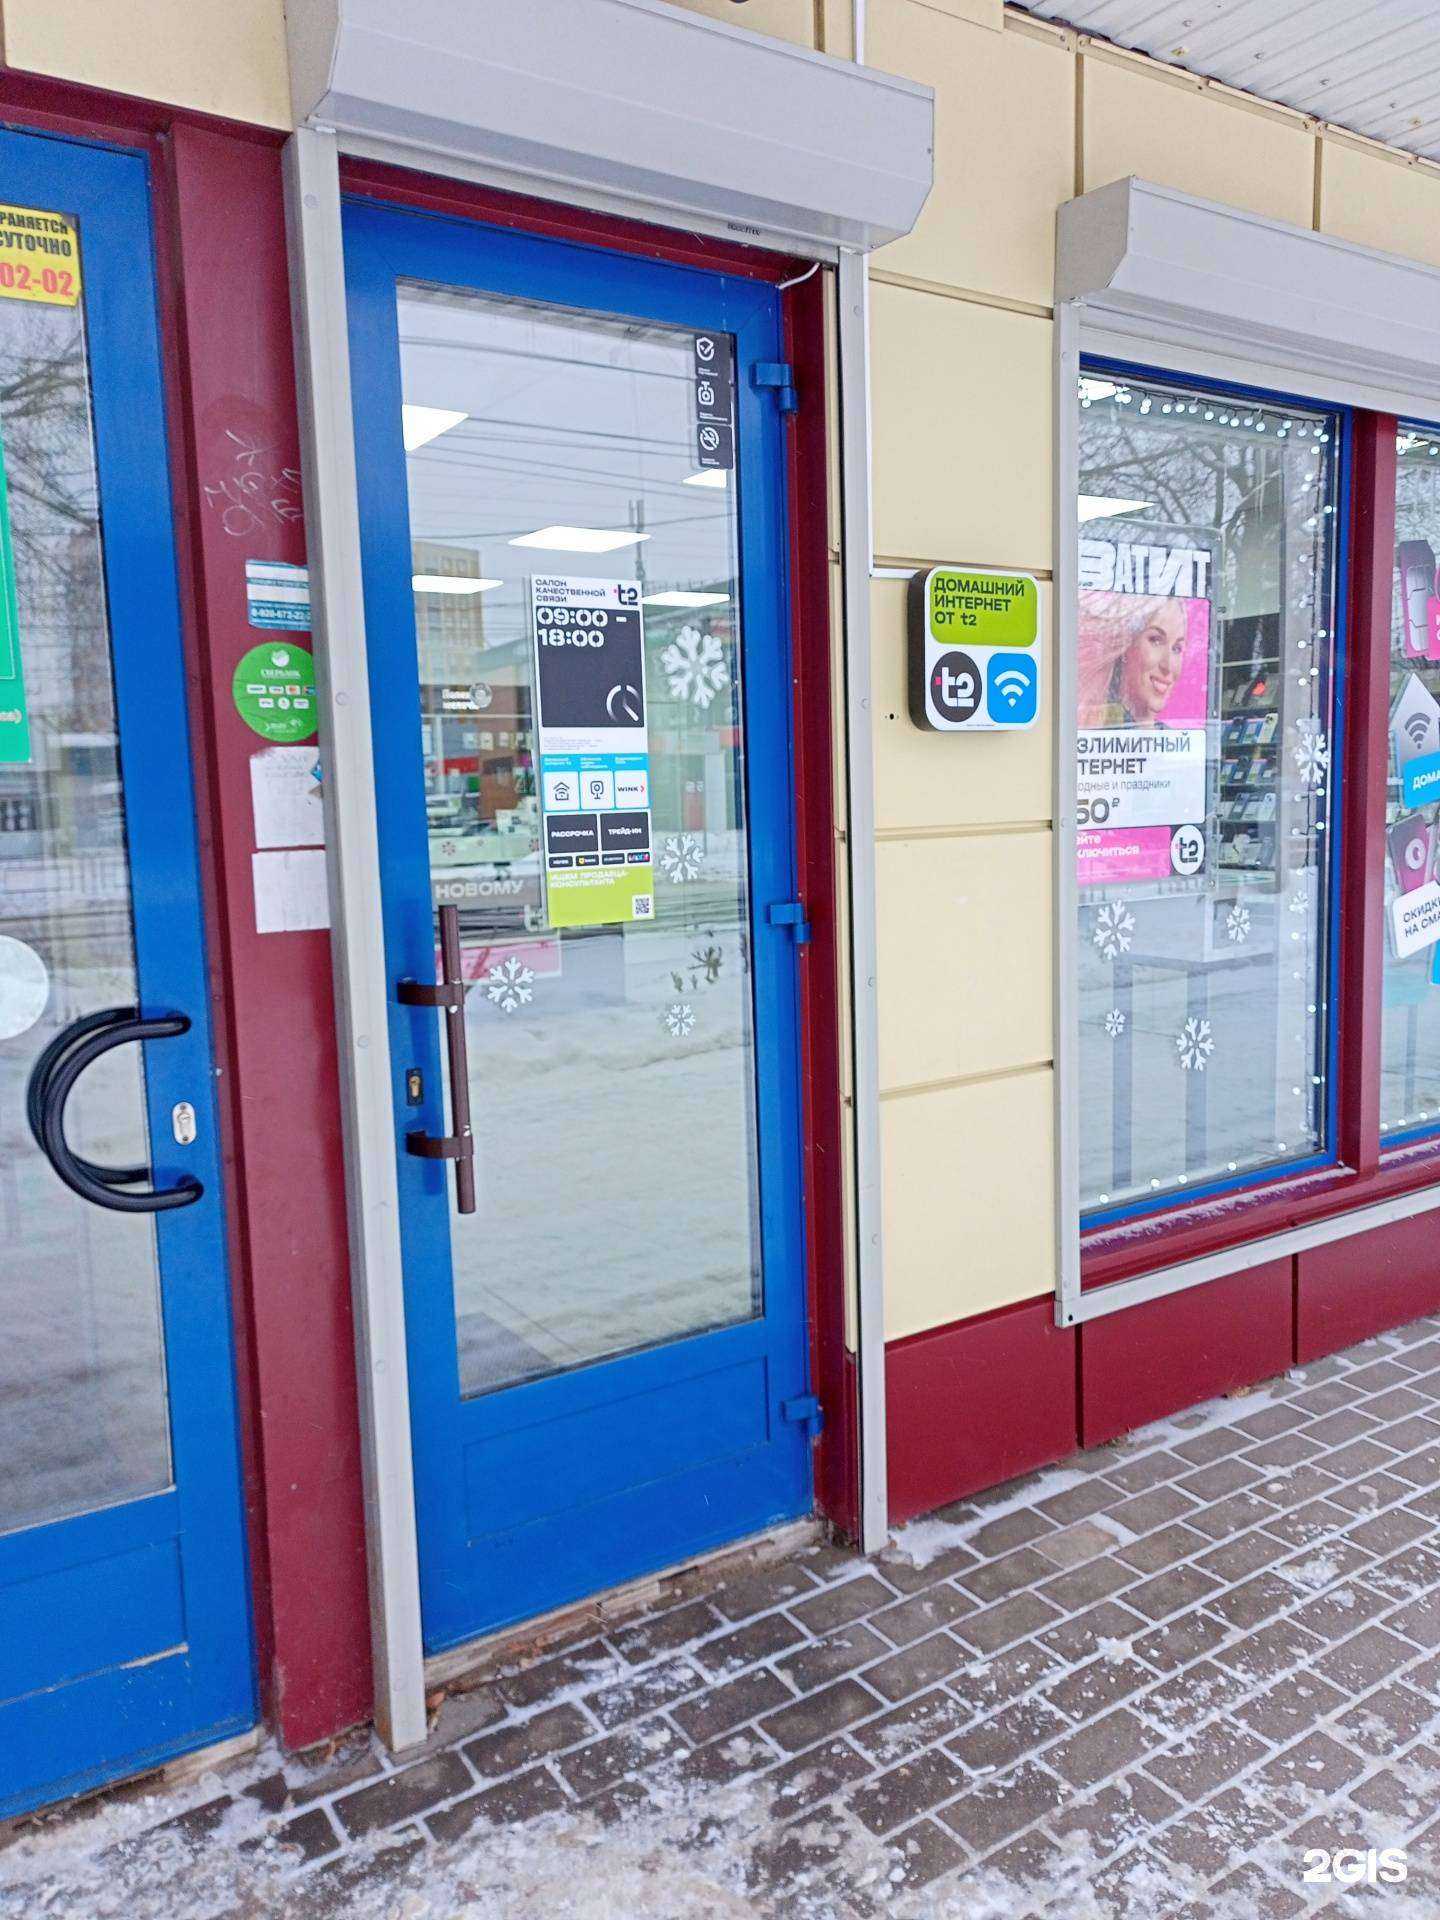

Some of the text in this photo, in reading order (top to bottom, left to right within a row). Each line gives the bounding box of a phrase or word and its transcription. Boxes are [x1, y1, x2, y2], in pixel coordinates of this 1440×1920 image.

[535, 579, 567, 587] САЛОН
[536, 587, 606, 597] КАЧЕСТВЕННОЙ
[934, 577, 1025, 597] ДОМАШНИЙ
[614, 584, 638, 606] t2
[934, 595, 1012, 612] ИНТЕРНЕТ
[537, 607, 608, 627] 09:00
[934, 611, 977, 626] ОТ t2
[538, 628, 605, 648] 18:00
[934, 667, 975, 707] t2
[1078, 757, 1147, 775] ТЕРНЕТ
[1120, 780, 1170, 792] праздники
[551, 829, 595, 838] РАССРОЧКА
[608, 826, 642, 836] ТРЕЙД-ИН
[1177, 837, 1199, 863] t2
[435, 880, 524, 899] НОВОМУ
